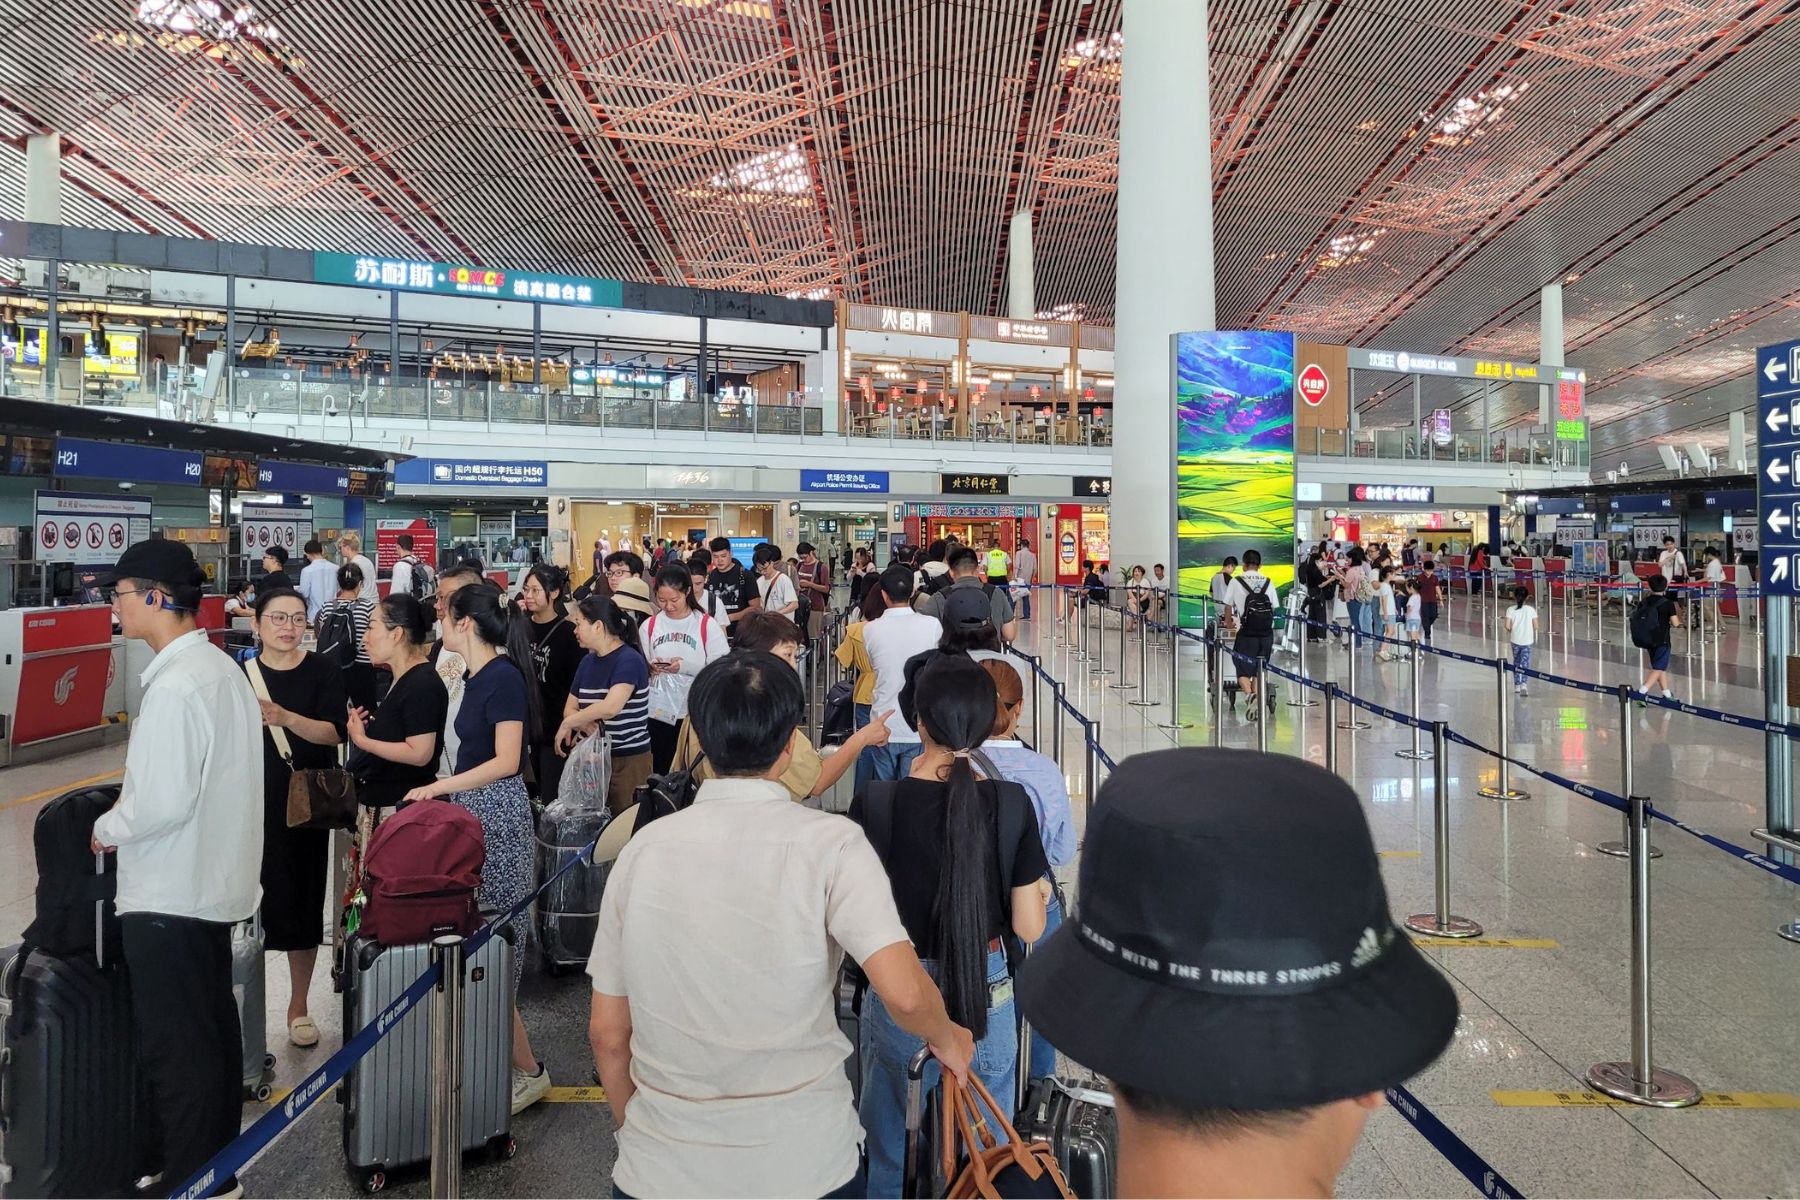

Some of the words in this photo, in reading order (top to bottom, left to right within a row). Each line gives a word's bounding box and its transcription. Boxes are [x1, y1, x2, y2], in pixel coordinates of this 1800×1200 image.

[354, 257, 434, 288] 苏耐斯
[57, 451, 78, 466] H21
[185, 462, 201, 476] H20
[259, 470, 273, 483] H19
[455, 464, 522, 475] 国内超规行李托运
[523, 467, 543, 476] H50
[337, 477, 348, 488] H18
[826, 473, 865, 482] 机场公安办证
[952, 476, 998, 490] 北京同仁堂
[652, 632, 697, 650] CHAMPION
[1121, 947, 1159, 971] WITH
[1168, 963, 1200, 980] THE
[1211, 969, 1268, 985] THREE
[1276, 962, 1341, 984] STRIPES
[295, 1088, 306, 1108] AIR
[307, 1071, 327, 1097] CHINA
[1398, 1094, 1418, 1120] CHINA
[188, 1167, 215, 1199] CHINA
